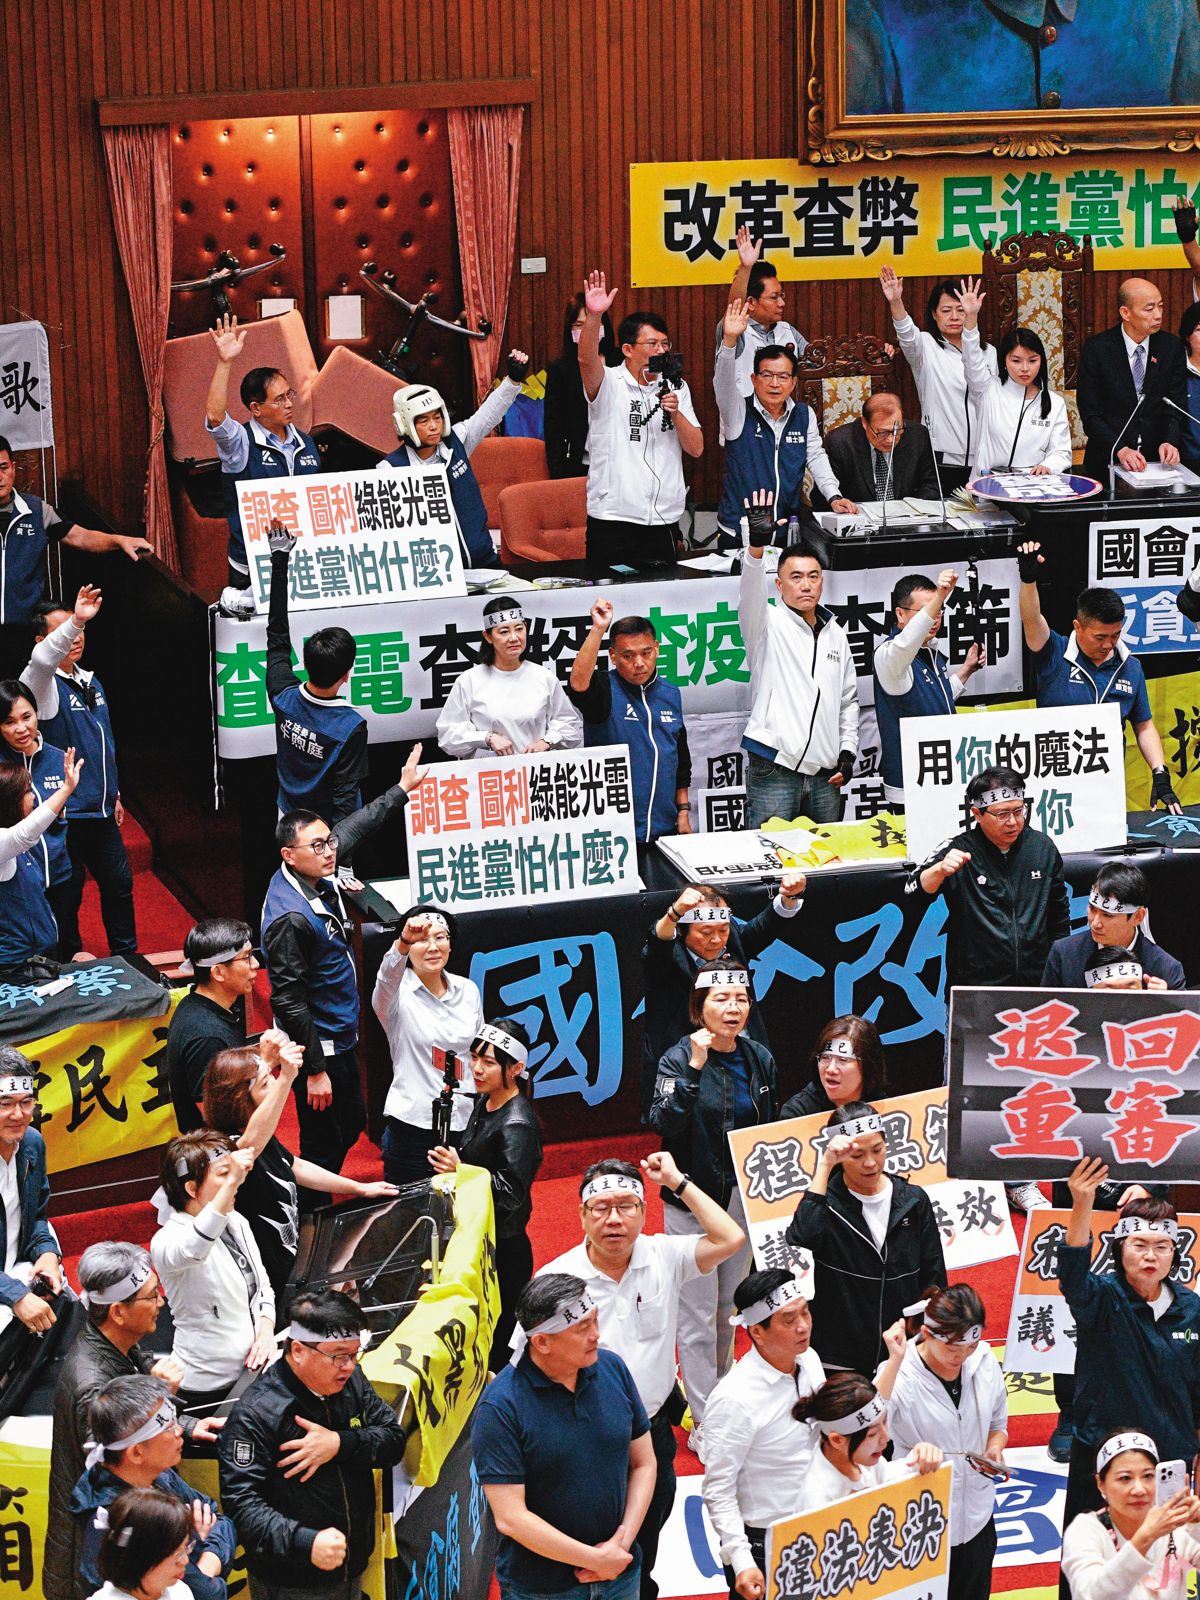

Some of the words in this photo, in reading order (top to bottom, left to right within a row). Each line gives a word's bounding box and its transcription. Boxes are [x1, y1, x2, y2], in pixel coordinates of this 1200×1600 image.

[663, 176, 919, 262] 改革查弊
[0, 360, 45, 414] 歌
[629, 400, 642, 442] 黃國昌
[241, 488, 303, 542] 調查
[305, 474, 451, 537] 圖利綠能光電
[216, 630, 412, 729] 查電
[648, 600, 778, 688] 查疫
[825, 582, 1010, 678] 查篩
[284, 719, 317, 739] 立法委員
[917, 727, 1110, 788] 用你的魔法
[409, 776, 470, 836] 調查
[478, 757, 630, 829] 圖利綠能光電
[417, 829, 629, 904] 民進黨怕什麼?
[693, 908, 733, 922] 民主已
[0, 1077, 35, 1094] 主已
[744, 1102, 950, 1203] 程黑
[1120, 1216, 1173, 1235] 民主已死
[775, 1490, 947, 1600] 違法表決
